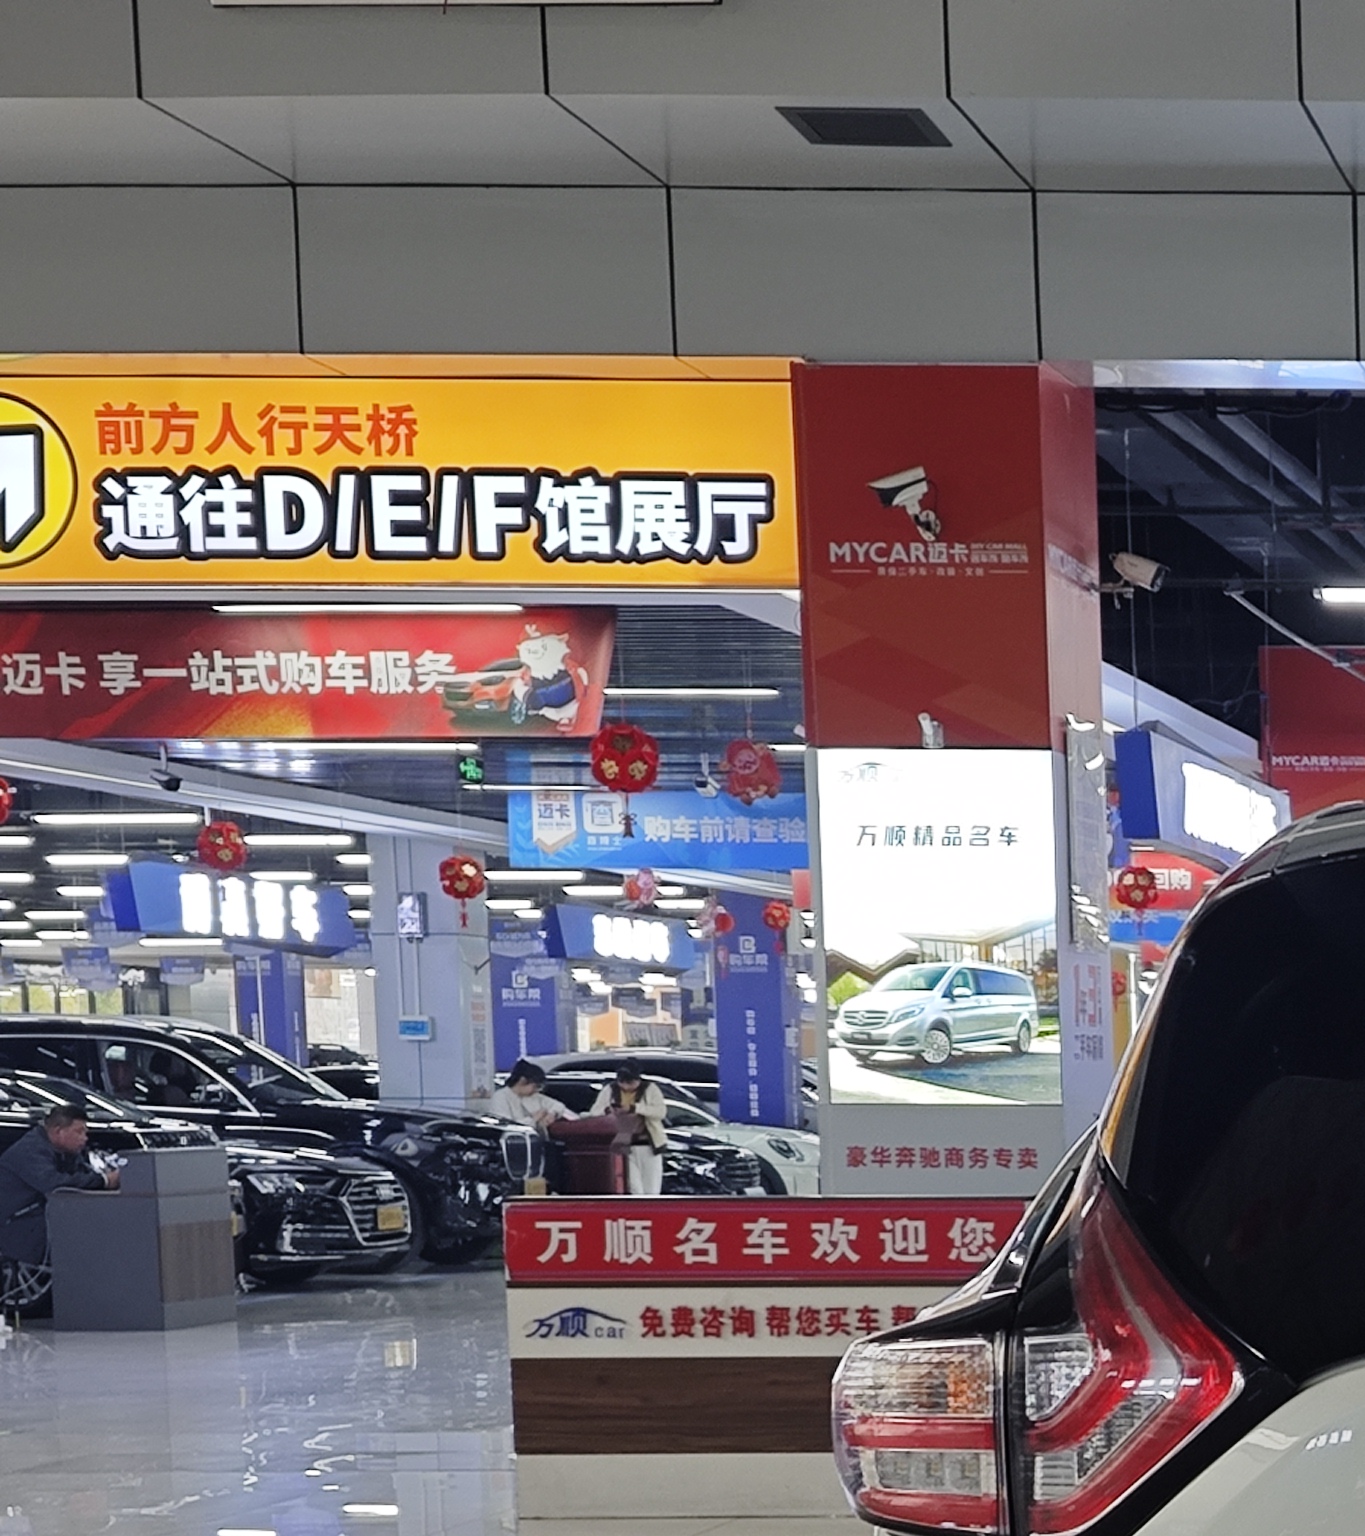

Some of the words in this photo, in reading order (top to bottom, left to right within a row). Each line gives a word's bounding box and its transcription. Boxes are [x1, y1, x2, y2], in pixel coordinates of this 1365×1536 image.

[94, 402, 419, 458] 前方人行天桥
[98, 470, 773, 559] 通往D/E/F馆展厅
[2, 650, 86, 694] 迈卡
[98, 650, 456, 697] 享一站式购车服务
[537, 802, 570, 820] 迈卡
[643, 815, 807, 844] 购车前请查验
[856, 824, 1020, 848] 万顺精品名车
[846, 1145, 1039, 1170] 豪华奔驰商务专卖
[535, 1215, 997, 1265] 万顺名车欢迎您
[523, 1309, 591, 1340] 万顺
[639, 1306, 756, 1338] 免费咨询
[766, 1305, 880, 1337] 帮您买车
